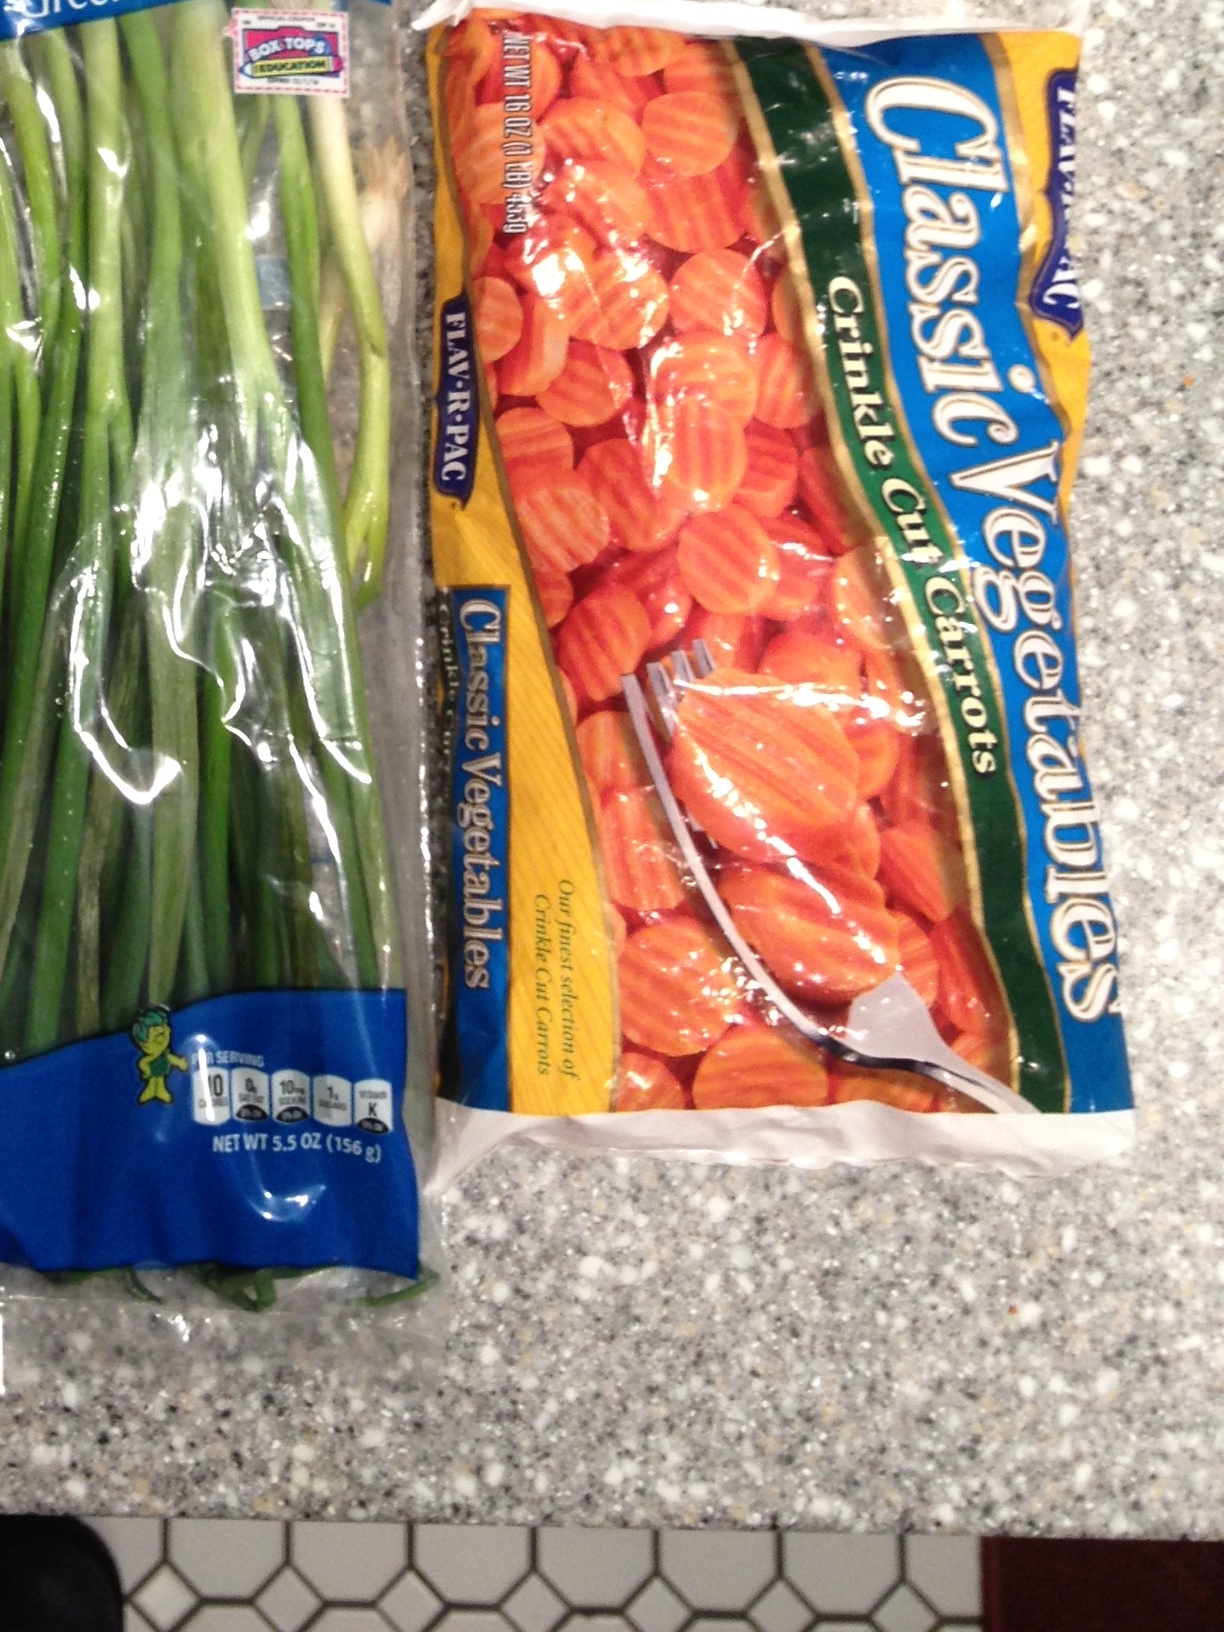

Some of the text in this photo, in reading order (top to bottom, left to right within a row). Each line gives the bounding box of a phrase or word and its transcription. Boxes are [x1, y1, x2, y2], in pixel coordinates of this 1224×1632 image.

[248, 37, 326, 61] BOX TOPS
[503, 35, 531, 59] NET
[504, 64, 531, 87] WT
[505, 94, 531, 112] 16
[504, 117, 531, 137] OZ
[827, 275, 998, 776] Crinkle Cut Carrots
[865, 75, 1123, 1022] Classic Vegetables
[457, 598, 503, 989] Classic Vegetables
[534, 894, 553, 1075] Crinkle Cut Carrots
[556, 879, 580, 1081] Our finest selection of
[368, 1102, 377, 1116] K
[213, 1134, 240, 1153] NET
[243, 1133, 268, 1151] WT
[272, 1135, 296, 1152] 5.5
[300, 1132, 322, 1149] OZ
[327, 1136, 362, 1156] (156
